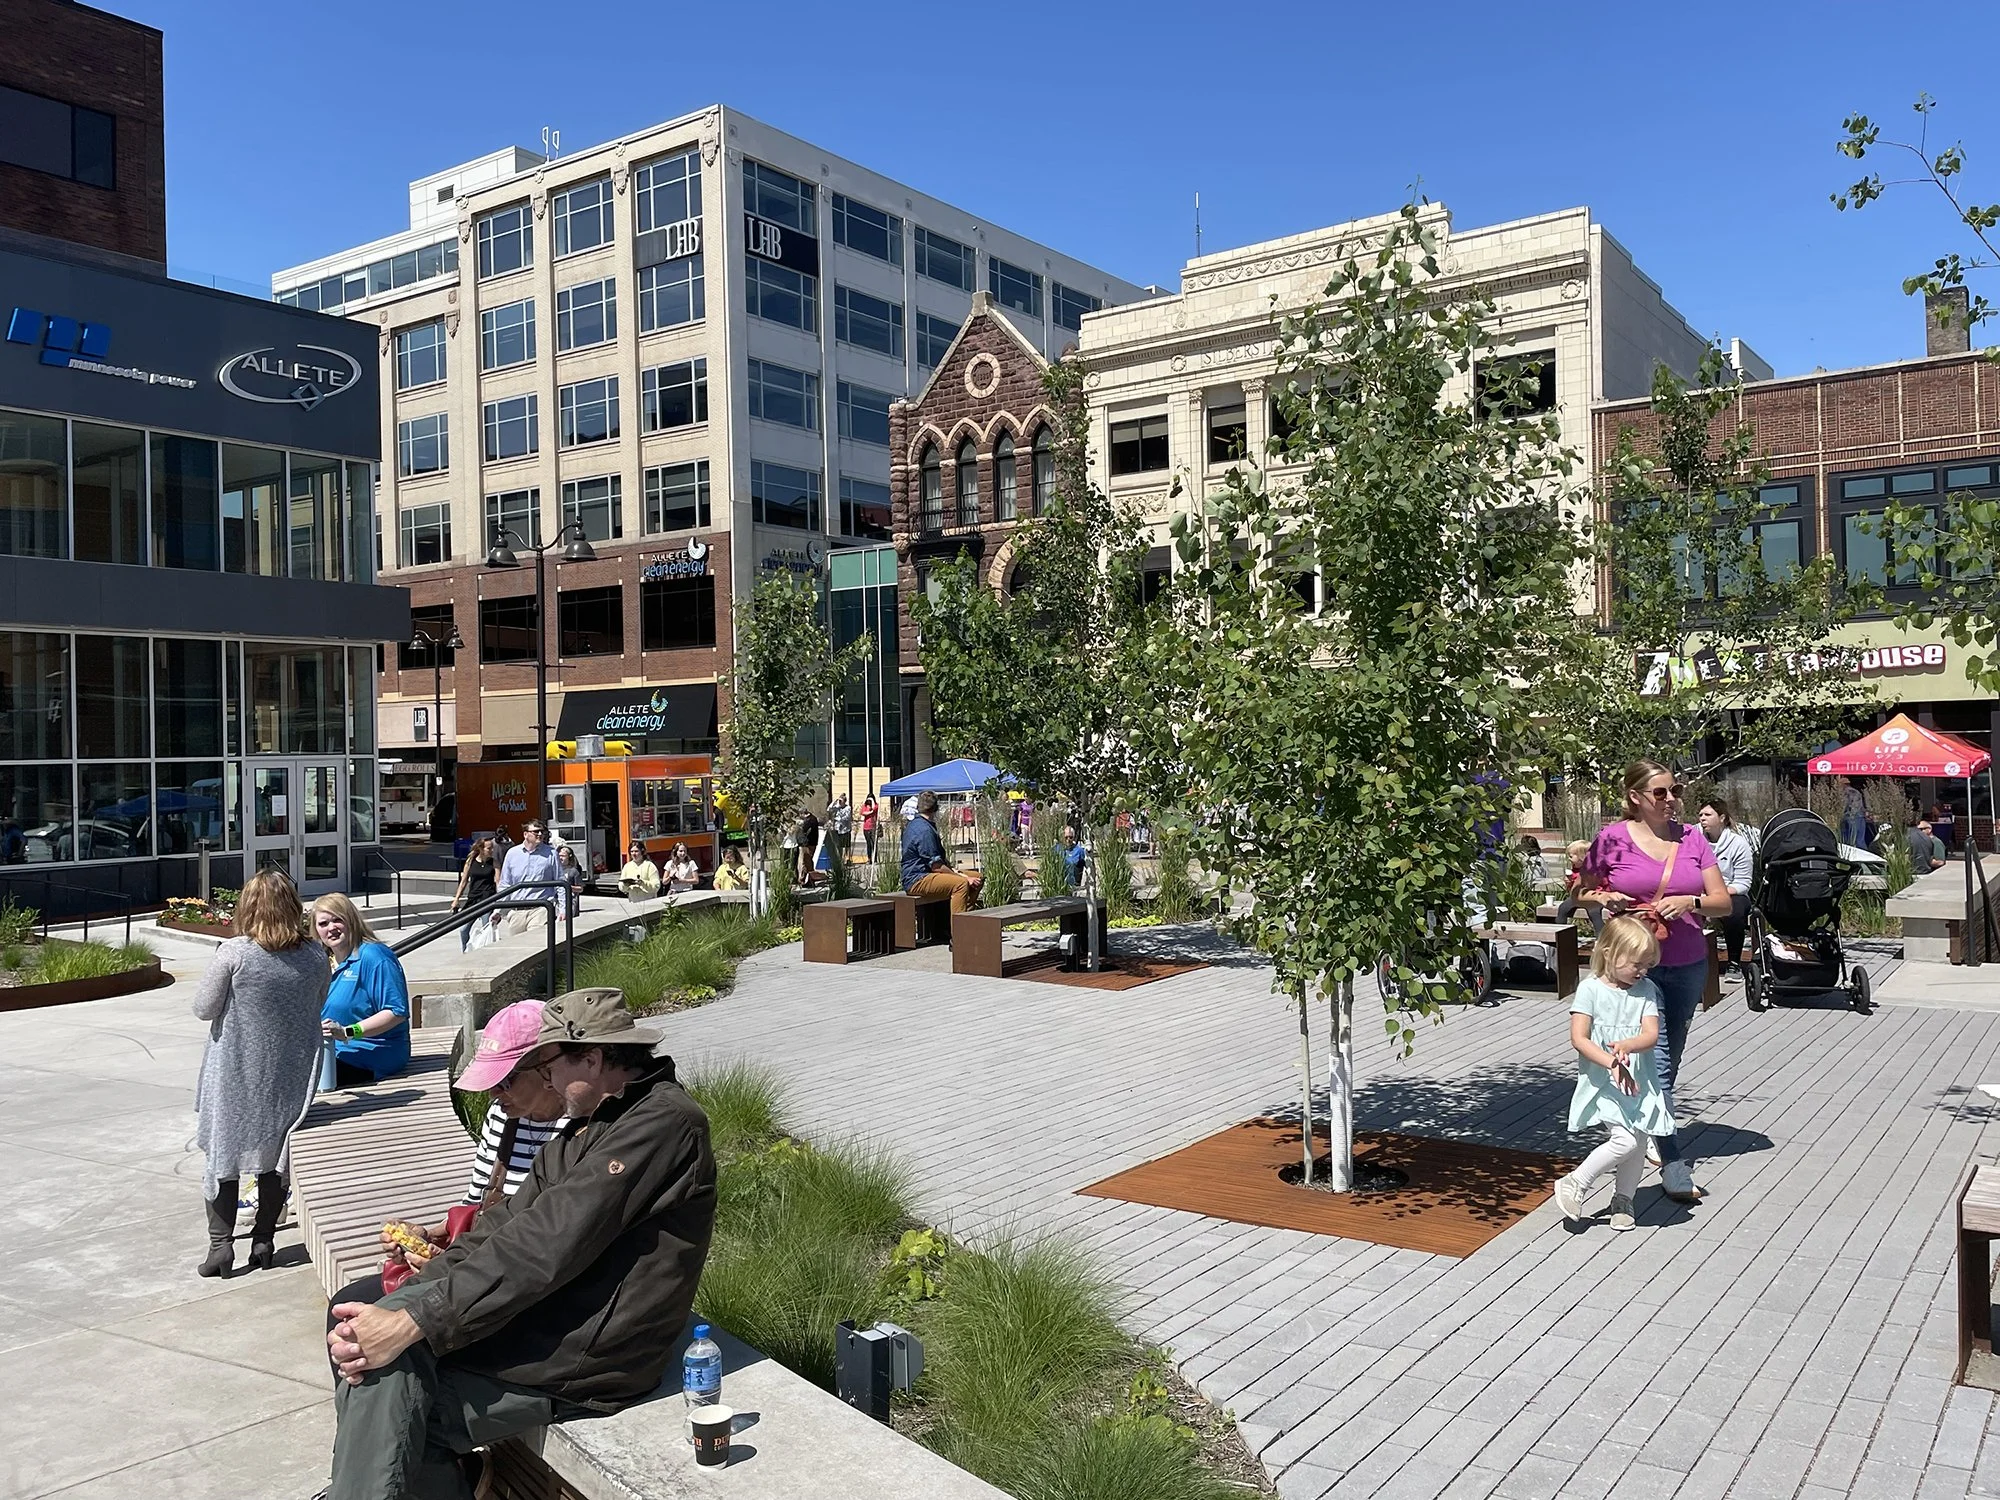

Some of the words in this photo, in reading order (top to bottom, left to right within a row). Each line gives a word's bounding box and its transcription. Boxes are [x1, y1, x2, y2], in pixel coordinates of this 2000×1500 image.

[665, 219, 700, 260] LHB
[747, 217, 782, 260] LHB
[68, 358, 149, 384] minnesota
[149, 373, 197, 389] power
[241, 354, 346, 387] ALLETE
[651, 550, 688, 562] ALLETE
[608, 704, 650, 715] ALLETE
[1874, 745, 1910, 754] LIFE
[1846, 761, 1930, 773] life973.com
